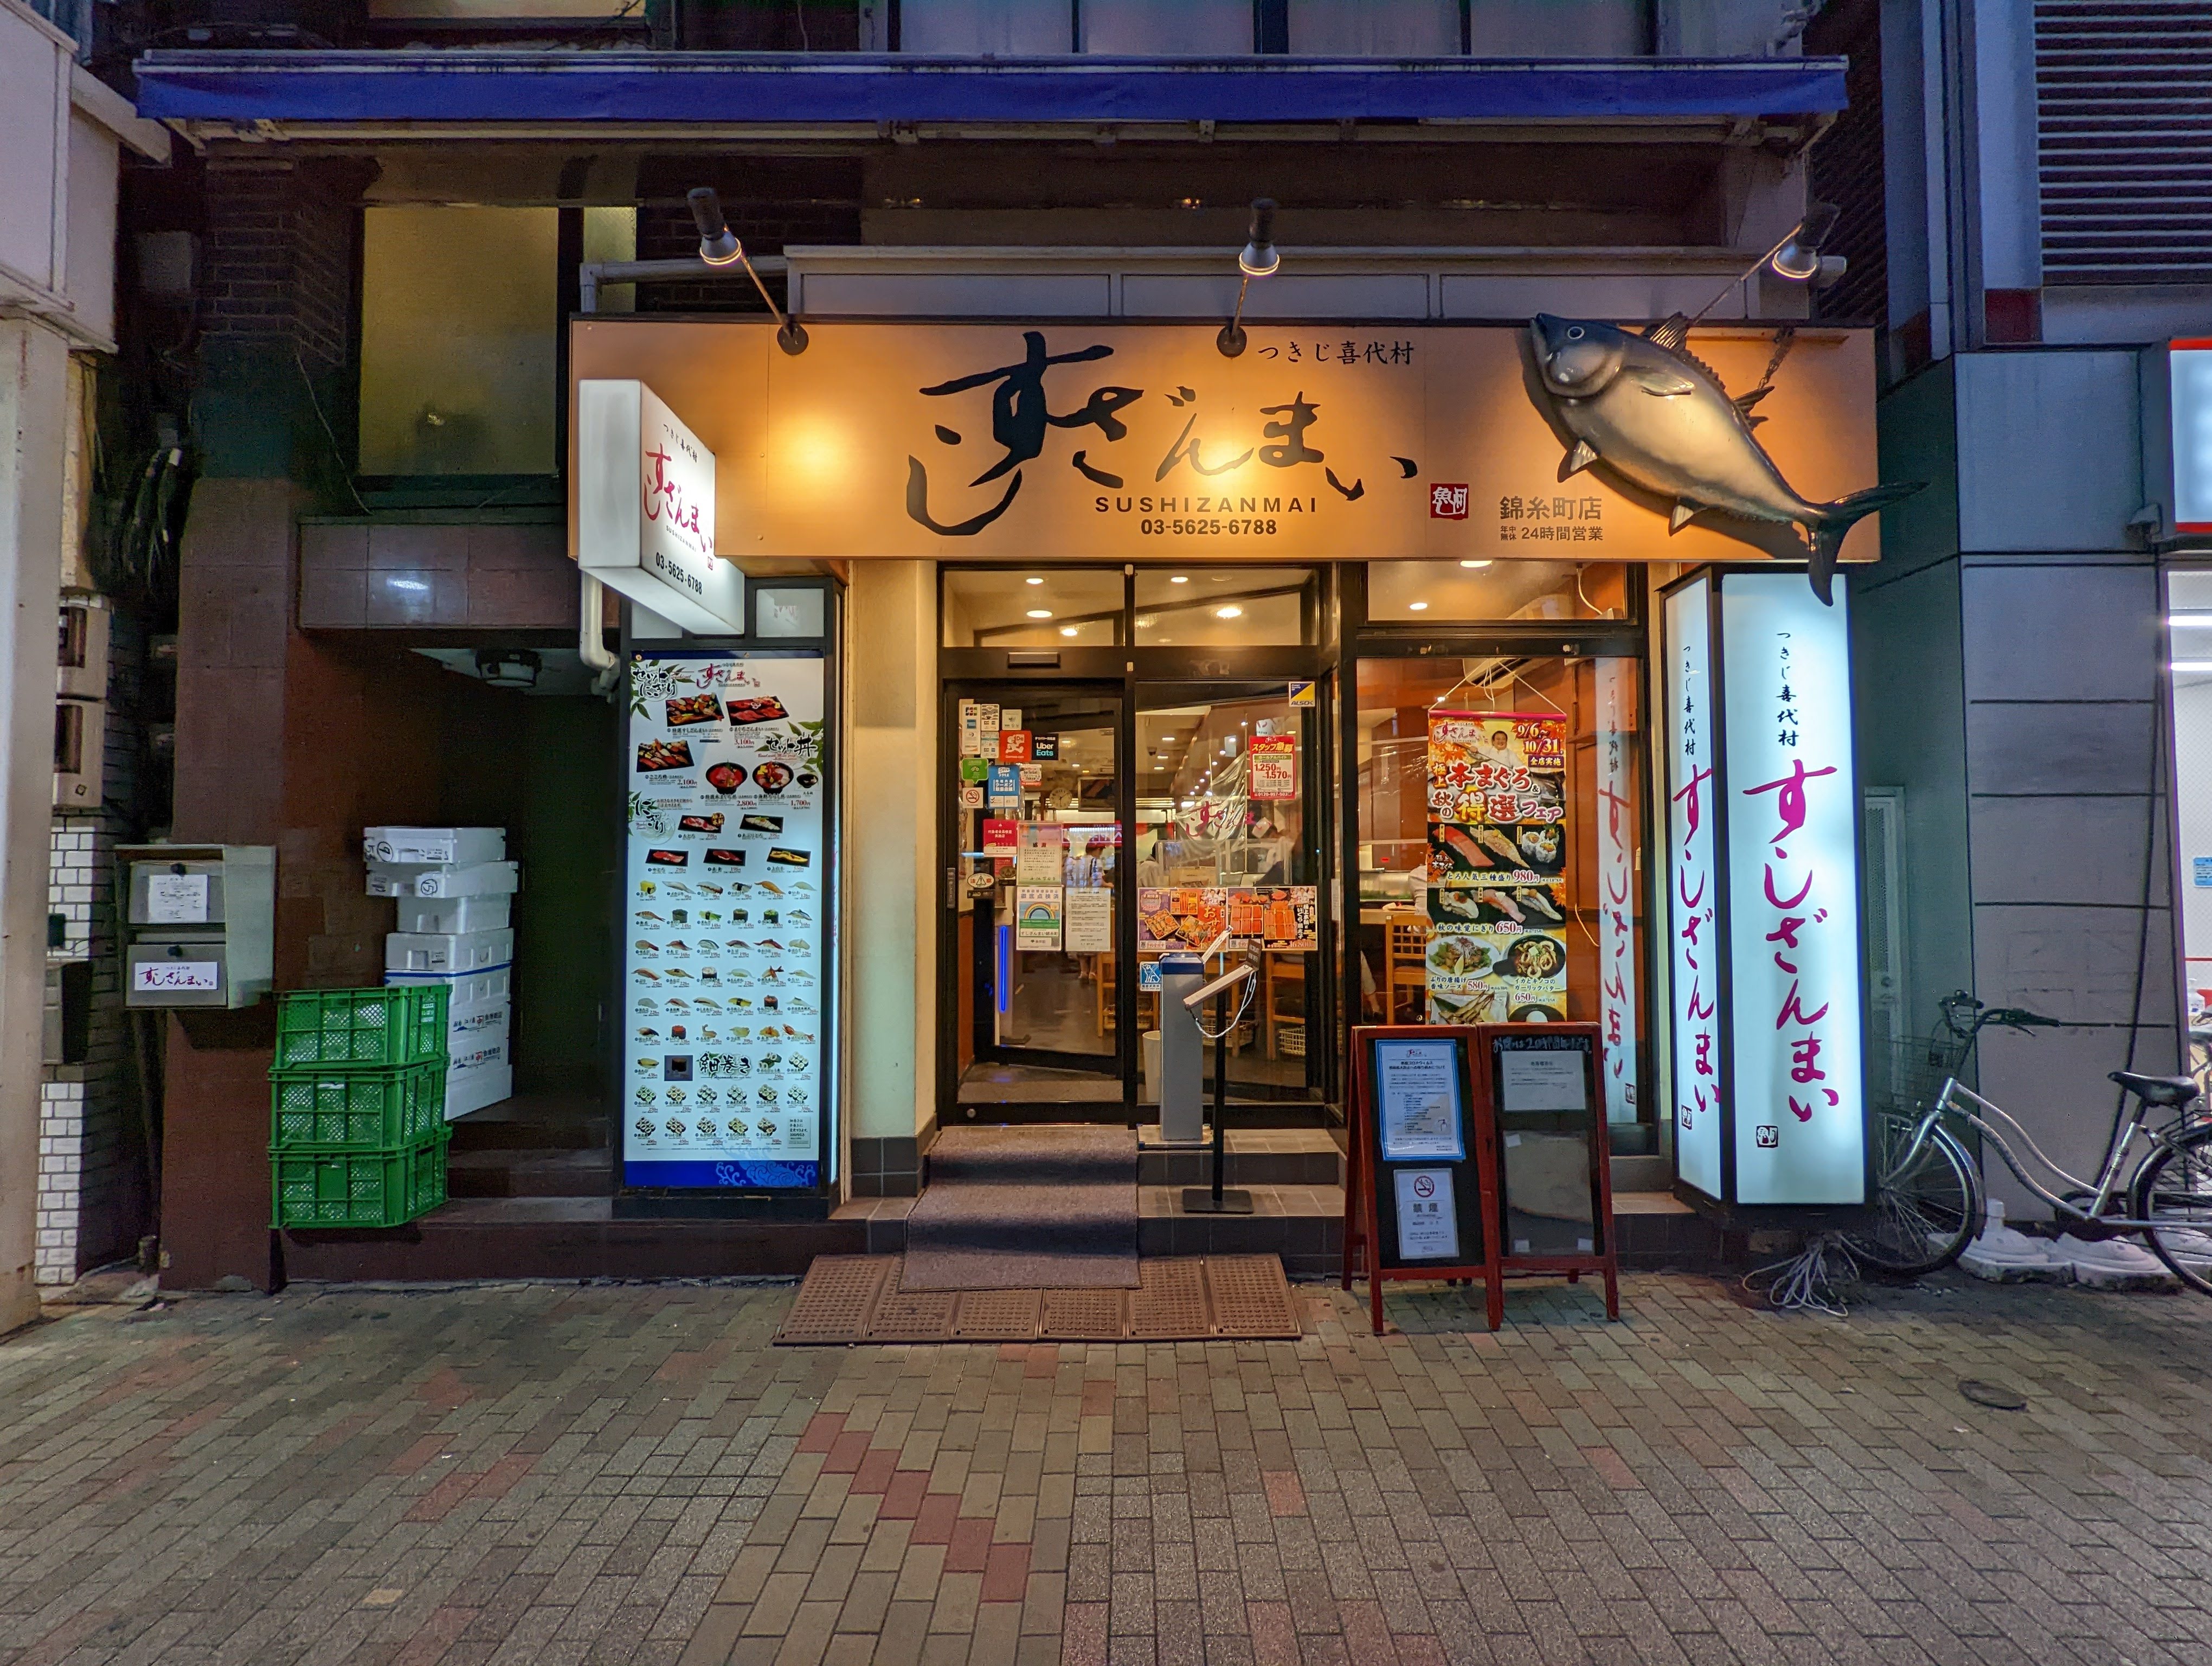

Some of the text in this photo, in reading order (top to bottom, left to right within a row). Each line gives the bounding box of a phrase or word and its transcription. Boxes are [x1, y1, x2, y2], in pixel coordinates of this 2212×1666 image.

[1258, 341, 1414, 364] つきじ喜代村
[663, 422, 697, 463] つきじ喜代村
[907, 331, 1417, 536] すしざんまい
[644, 443, 712, 552] すしざんまい
[1095, 497, 1317, 513] SUSHIZANMAI
[1500, 496, 1602, 520] 錦糸町店
[1141, 518, 1277, 536] 03-5625-6788
[1521, 526, 1603, 541] 24時間営業
[666, 525, 697, 552] SUSHIZANMAI
[656, 552, 703, 595] 03-5625-6788
[632, 667, 668, 682] セット
[639, 683, 676, 697] にぎり
[1776, 632, 1799, 747] つきじ喜代村
[1683, 646, 1696, 756] つきじ喜代村
[1433, 721, 1486, 744] すしざんまい
[766, 733, 818, 757] セット丼
[1251, 742, 1294, 753] スタッフ急募
[1524, 738, 1560, 753] 10/31
[1254, 763, 1281, 771] 1,250円
[1530, 757, 1562, 766] 全店実施
[1433, 762, 1446, 788] 極上
[1448, 762, 1531, 790] 本まぐろ
[1447, 872, 1512, 882] とろ人気三種盛り
[1513, 870, 1540, 882] 980円
[1203, 905, 1220, 938] おせち
[1438, 923, 1494, 933] 秋の味覚にぎり
[1495, 921, 1523, 934] 650円
[1673, 764, 1720, 1112] すしざんまい
[1742, 759, 1840, 1123] すしざんまい
[138, 967, 208, 986] すしざんまい
[1467, 981, 1489, 991] 580円
[1514, 992, 1536, 1002] 650円
[700, 1053, 751, 1074] 細巻き
